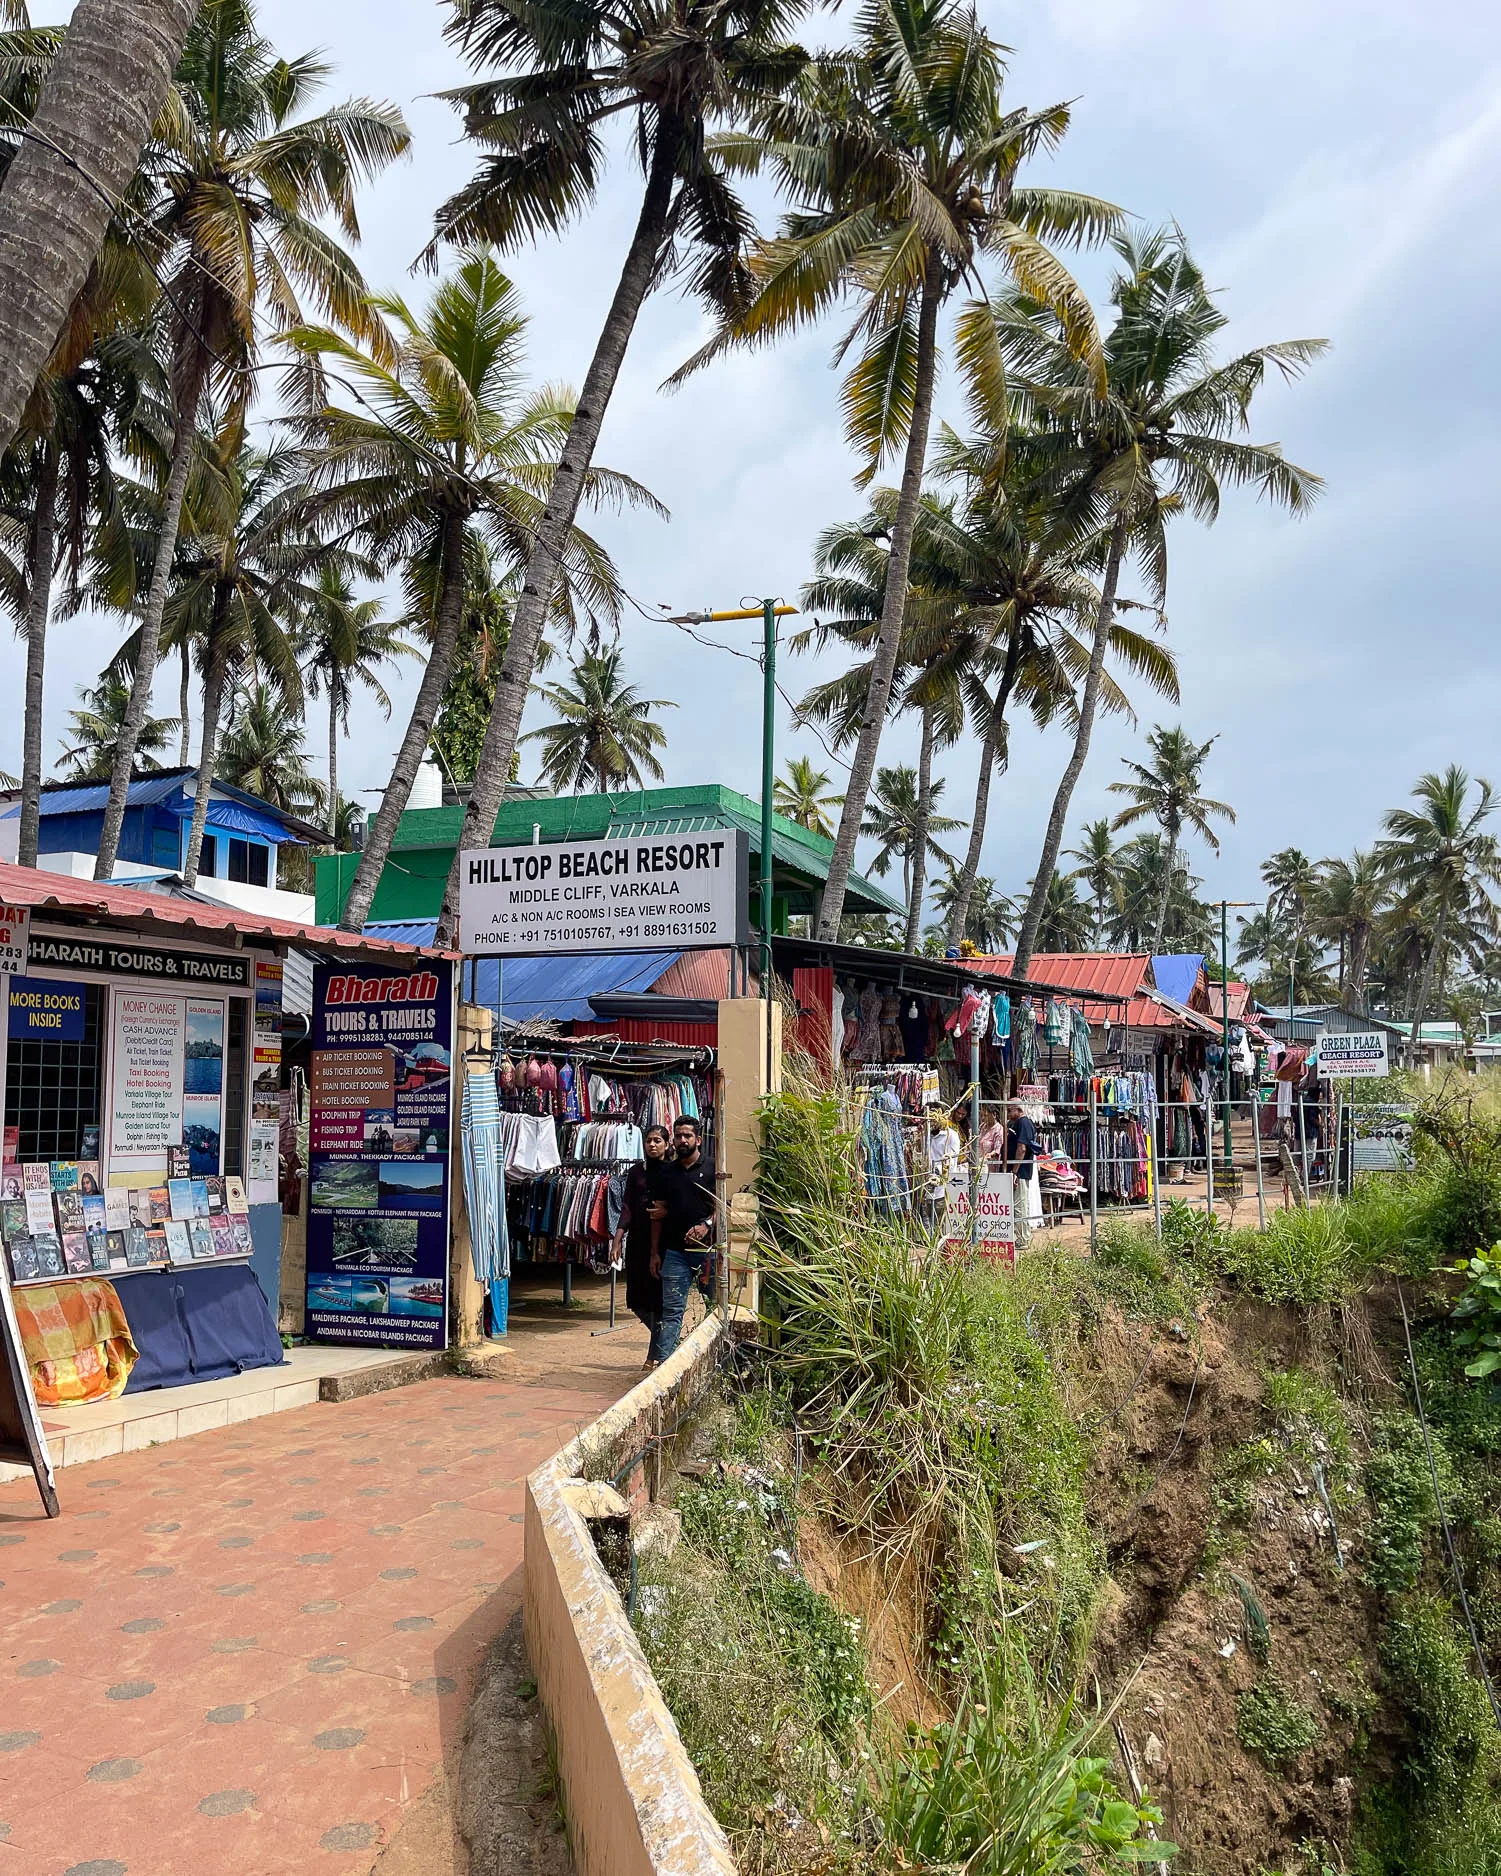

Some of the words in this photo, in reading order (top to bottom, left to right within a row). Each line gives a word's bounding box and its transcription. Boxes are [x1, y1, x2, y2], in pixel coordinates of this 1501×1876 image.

[468, 855, 552, 884] HILLTOP
[559, 849, 629, 878] BEACH
[636, 842, 724, 873] RESORT
[509, 888, 560, 904] MIDDLE
[564, 885, 606, 900] CLIFF,
[610, 881, 680, 898] VARKALA
[491, 912, 508, 924] A/C
[511, 912, 518, 923] &
[521, 911, 543, 922] NON
[546, 910, 564, 921] A/C
[566, 908, 605, 920] ROOMS
[614, 906, 635, 918] SEA
[638, 904, 666, 917] VIEW
[669, 902, 711, 916] ROOMS
[474, 932, 510, 944] PHONE
[519, 930, 540, 942] +91
[543, 927, 615, 940] 7510105767,
[618, 925, 639, 938] +91
[644, 921, 717, 937] 8891631502
[1, 960, 18, 972] 44
[108, 950, 163, 972] TOURS
[165, 955, 178, 974] &
[182, 960, 243, 981] TRAVELS
[325, 971, 438, 1005] Bharath
[10, 991, 42, 1008] MORE
[44, 994, 80, 1011] BOOKS
[123, 1000, 147, 1013] MONEY
[149, 1002, 177, 1015] CHANGE
[29, 1012, 62, 1028] INSIDE
[139, 1016, 158, 1025] Currency
[324, 1011, 366, 1032] TOURS
[368, 1014, 378, 1030] &
[381, 1009, 436, 1030] TRAVELS
[122, 1026, 142, 1034] CASH
[144, 1027, 177, 1035] ADVANCE
[159, 1038, 174, 1047] Card)
[326, 1035, 338, 1043] PH:
[339, 1034, 386, 1042] 9995138283,
[388, 1032, 433, 1041] 9447085144
[1321, 1037, 1350, 1050] GREEN
[1354, 1036, 1381, 1049] PLAZA
[334, 1053, 352, 1061] TICKET
[354, 1052, 383, 1060] BOOKING
[1322, 1052, 1348, 1060] BEACH
[139, 1058, 151, 1066] Ticket
[152, 1059, 169, 1068] Booking
[129, 1068, 142, 1077] Taxi
[143, 1069, 169, 1078] Booking
[322, 1068, 333, 1076] BUS
[334, 1067, 353, 1075] TICKET
[355, 1067, 384, 1075] BOOKING
[126, 1080, 144, 1088] Hotel
[146, 1080, 172, 1089] Booking
[322, 1082, 339, 1090] TRAIN
[340, 1082, 359, 1090] TICKET
[360, 1081, 390, 1090] BOOKING
[124, 1090, 144, 1098] Varkala
[144, 1090, 161, 1100] Village
[397, 1093, 414, 1102] MUNROE
[415, 1094, 428, 1102] ISLAND
[428, 1093, 446, 1102] PACKAGE
[131, 1101, 154, 1110] Elephant
[322, 1097, 340, 1105] HOTEL
[341, 1096, 370, 1104] BOOKING
[397, 1106, 414, 1114] GOLDEN
[414, 1106, 427, 1114] ISLAND
[428, 1106, 446, 1114] PACKAGE
[136, 1111, 151, 1119] Island
[152, 1112, 169, 1121] Village
[321, 1126, 345, 1134] FISHING
[346, 1126, 358, 1134] TRIP
[146, 1133, 160, 1141] Fishing
[320, 1140, 349, 1149] ELEPHANT
[350, 1140, 364, 1149] RIDE
[25, 1166, 30, 1174] IT
[32, 1165, 48, 1174] ENDS
[26, 1174, 42, 1182] WITH
[958, 1192, 1000, 1203] AHAY
[948, 1203, 970, 1214] SLK
[977, 1204, 1010, 1216] OUSE
[990, 1220, 1012, 1230] SHOP
[312, 1314, 339, 1323] MALDIVES
[340, 1315, 368, 1325] PACKAGE,
[370, 1317, 410, 1327] LAKSHADWEEP
[411, 1321, 439, 1330] PACKAGE
[316, 1327, 346, 1336] ANDAMAN
[353, 1330, 379, 1339] NICOBAR
[380, 1332, 404, 1340] ISLANDS
[405, 1334, 433, 1343] PACKAGE
